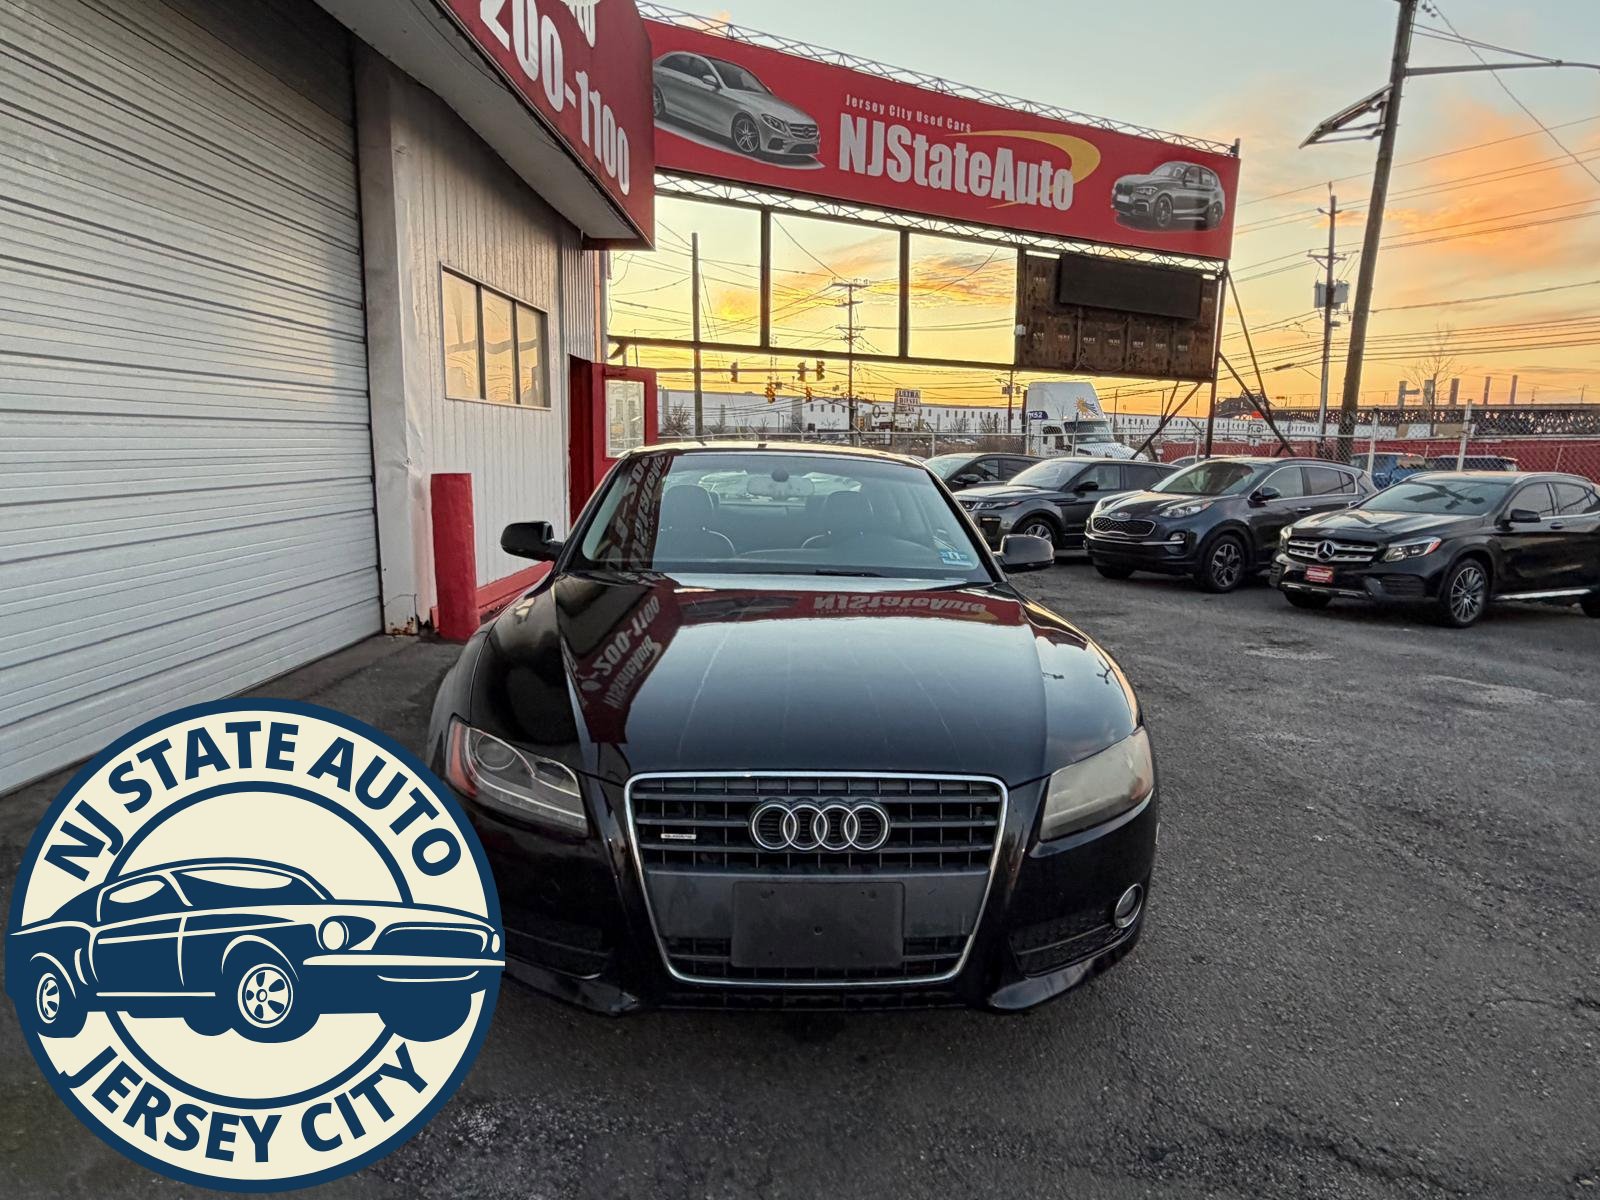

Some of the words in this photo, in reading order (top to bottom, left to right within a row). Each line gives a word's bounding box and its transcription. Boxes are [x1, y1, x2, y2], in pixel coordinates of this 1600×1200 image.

[845, 94, 885, 115] Jersey
[889, 105, 912, 121] City
[916, 111, 943, 127] Used
[947, 118, 971, 133] Cars
[839, 113, 1074, 211] NJStateAuto
